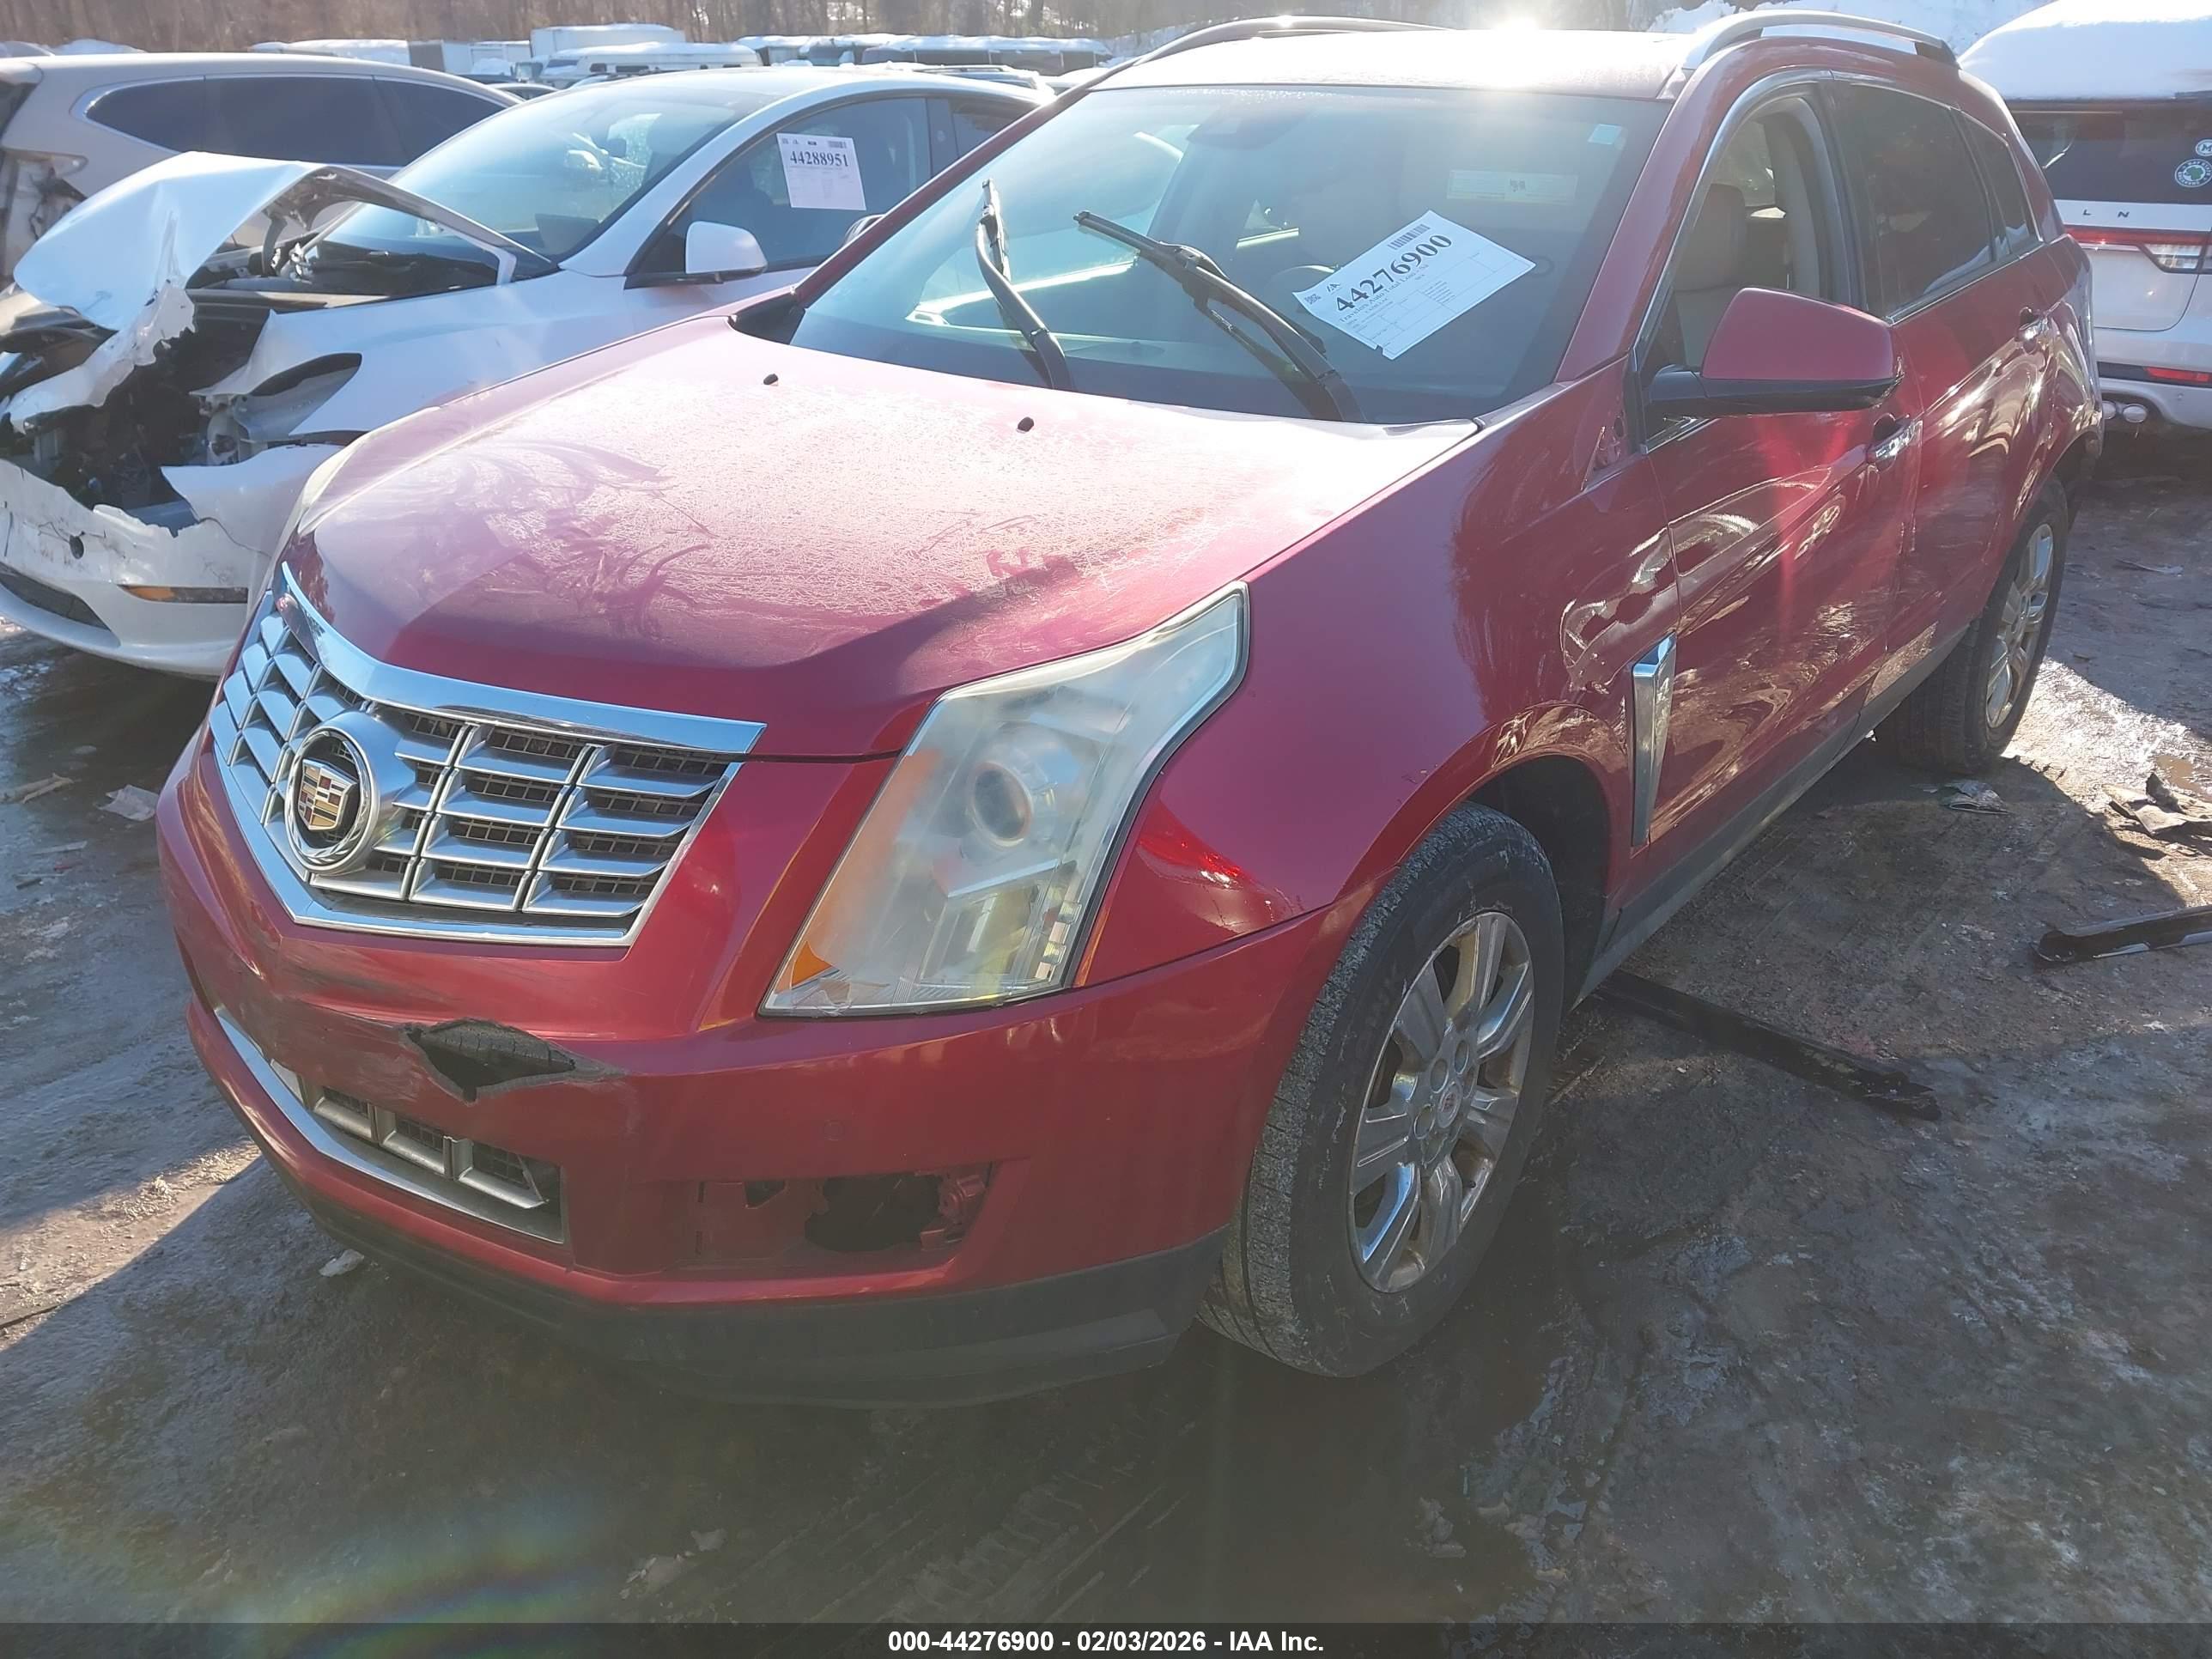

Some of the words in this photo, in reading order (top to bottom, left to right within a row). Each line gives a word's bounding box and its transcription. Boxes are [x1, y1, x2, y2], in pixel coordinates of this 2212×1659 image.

[790, 150, 848, 167] 44288951
[1336, 234, 1453, 312] 44276900
[1369, 291, 1386, 305] Auto
[1385, 281, 1402, 294] Total
